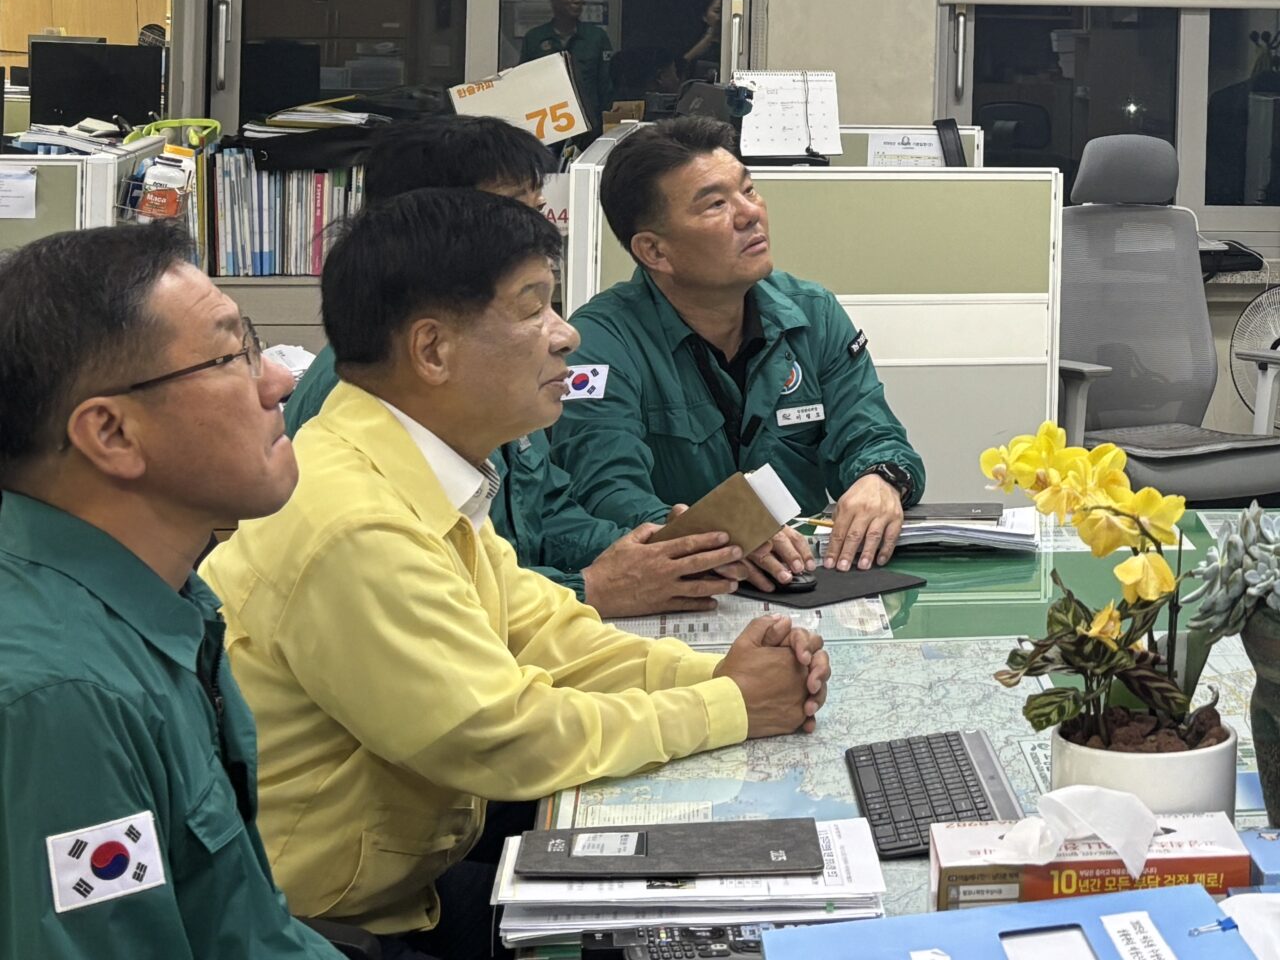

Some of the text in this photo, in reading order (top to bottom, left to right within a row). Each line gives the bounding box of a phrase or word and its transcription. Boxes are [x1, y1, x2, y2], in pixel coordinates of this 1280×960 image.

[525, 101, 576, 139] 75
[545, 208, 569, 224] A4
[1050, 869, 1101, 895] 10년간
[1104, 876, 1131, 890] 모든
[1164, 874, 1190, 886] 걱정
[1193, 872, 1224, 888] 제로!
